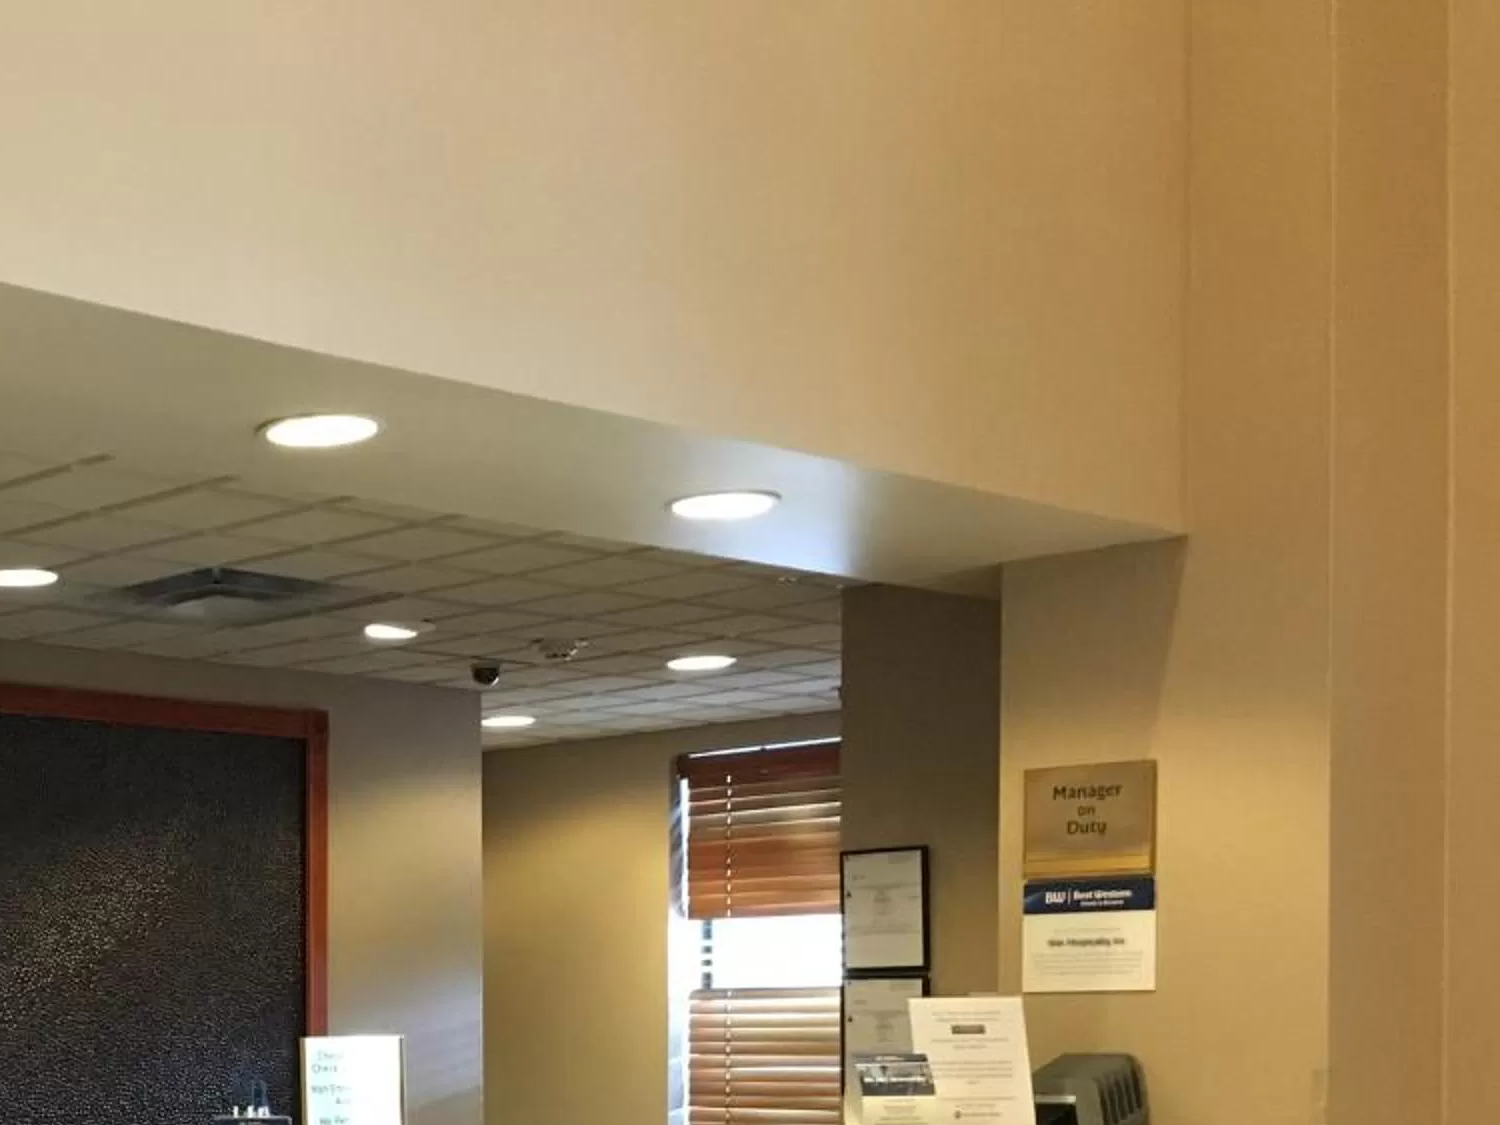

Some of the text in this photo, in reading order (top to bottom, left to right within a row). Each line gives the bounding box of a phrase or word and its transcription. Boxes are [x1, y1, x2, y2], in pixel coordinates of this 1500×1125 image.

[1052, 784, 1123, 801] Manager
[1077, 805, 1096, 817] on
[1066, 820, 1107, 836] Duty
[1073, 889, 1093, 901] Best
